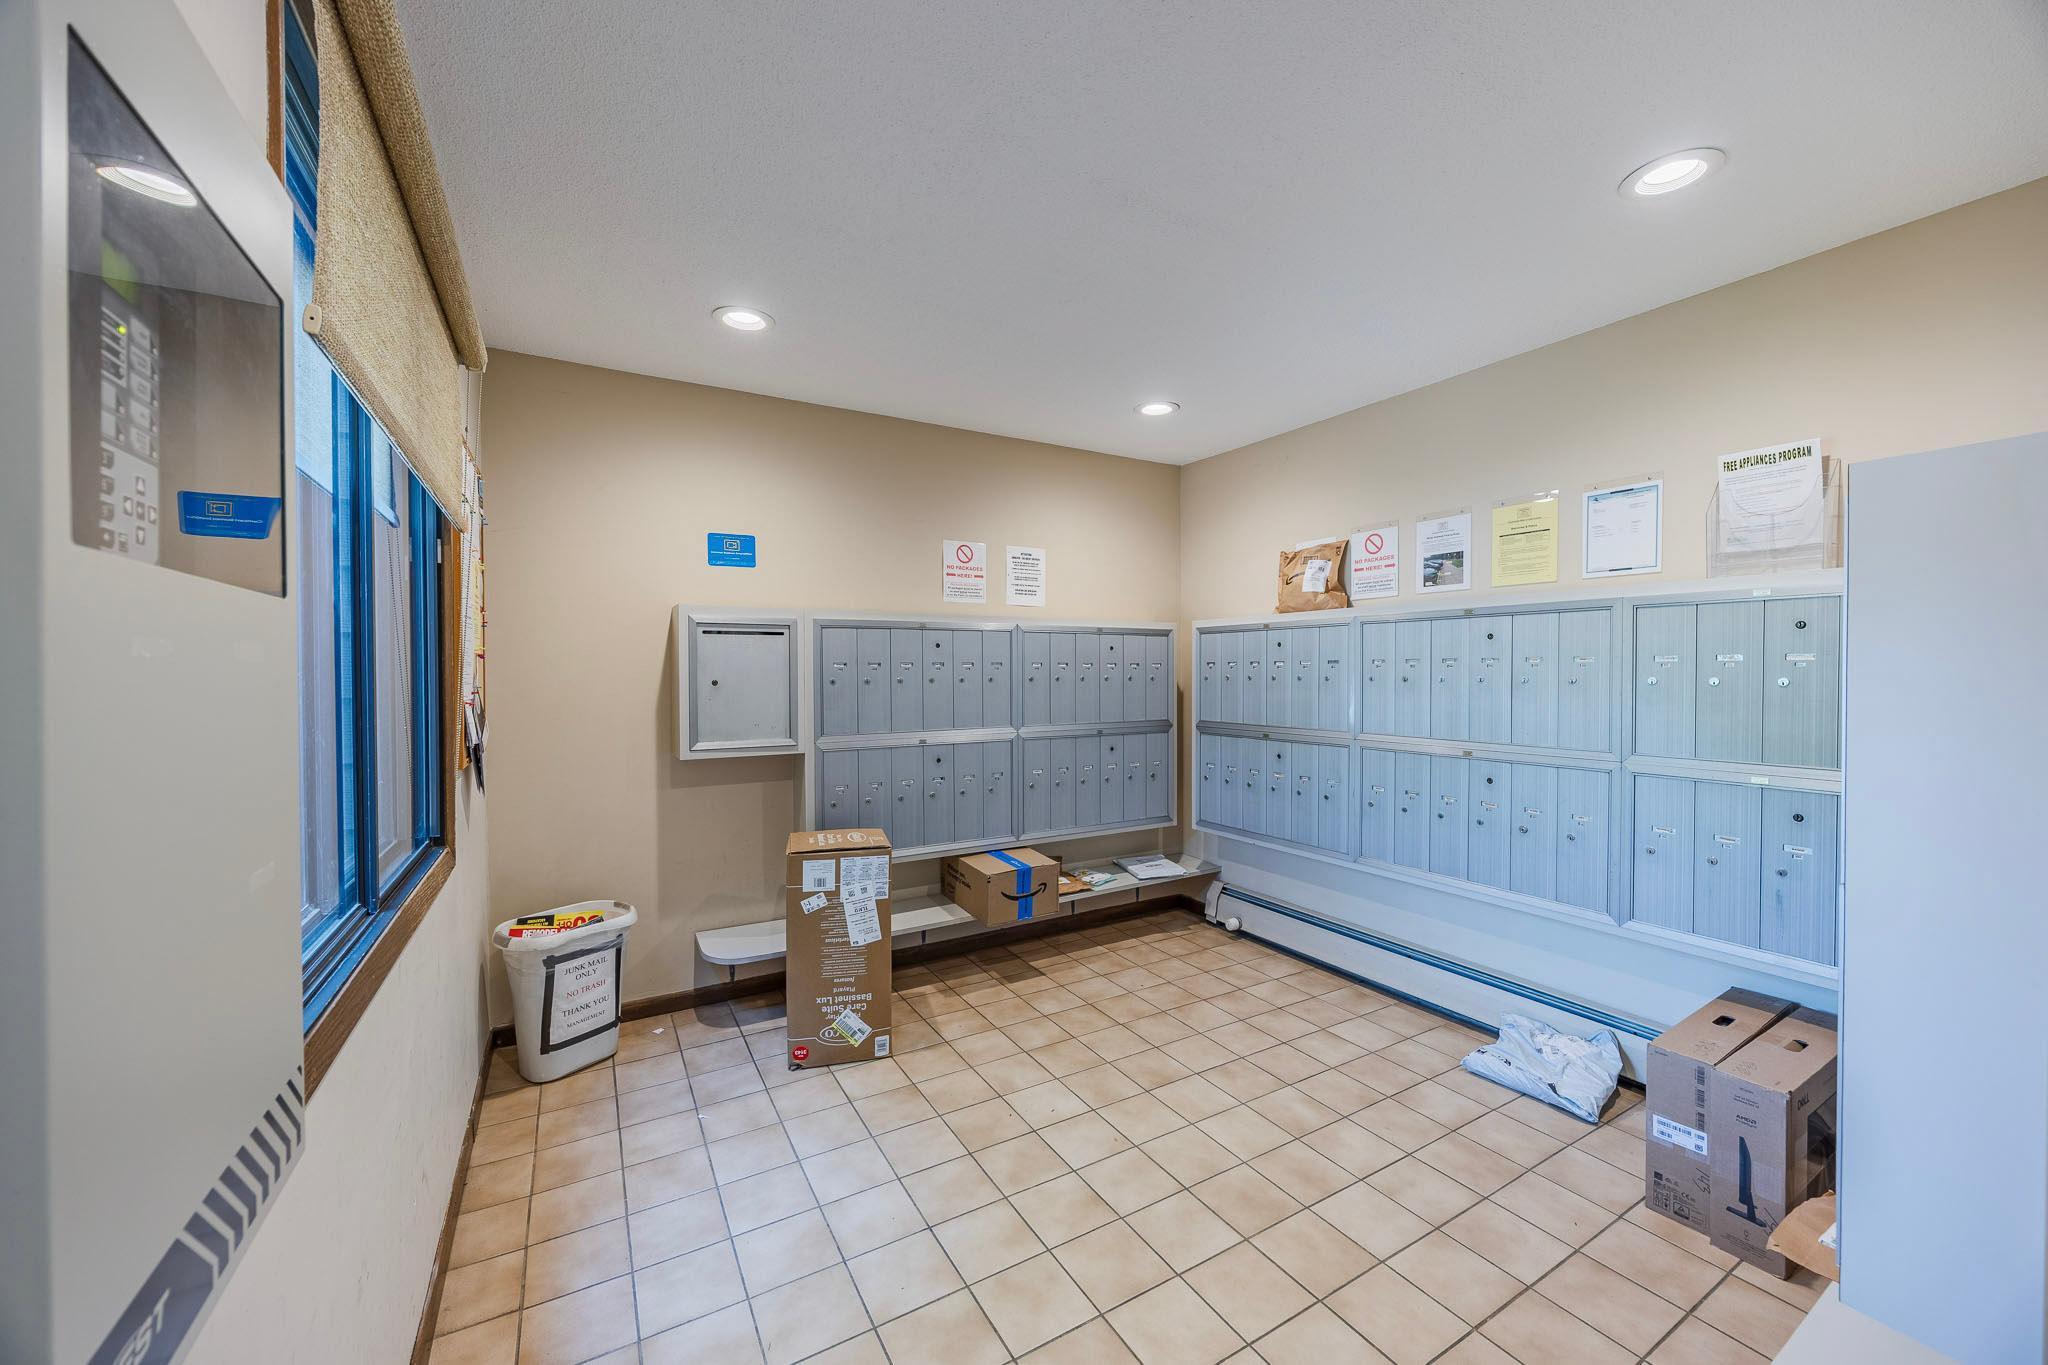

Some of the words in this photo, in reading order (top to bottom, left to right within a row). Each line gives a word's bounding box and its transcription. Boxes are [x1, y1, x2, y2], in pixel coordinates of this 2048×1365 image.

[1723, 459, 1737, 472] FREE
[1739, 453, 1777, 470] APPLIANCES
[1778, 446, 1812, 463] PROGRAM
[1364, 555, 1395, 563] PACKAGES
[564, 963, 586, 976] JUNK
[587, 956, 608, 968] MAIL
[575, 967, 598, 980] ONLY
[566, 989, 579, 999] NO
[580, 979, 606, 993] TRASH
[816, 996, 832, 1004] Lux
[835, 992, 872, 1003] Bassinet
[560, 1002, 592, 1018] THANK
[593, 994, 609, 1006] YOU
[821, 1004, 844, 1013] Suite
[847, 1002, 867, 1012] Care
[567, 1010, 605, 1028] MANAGEMENT
